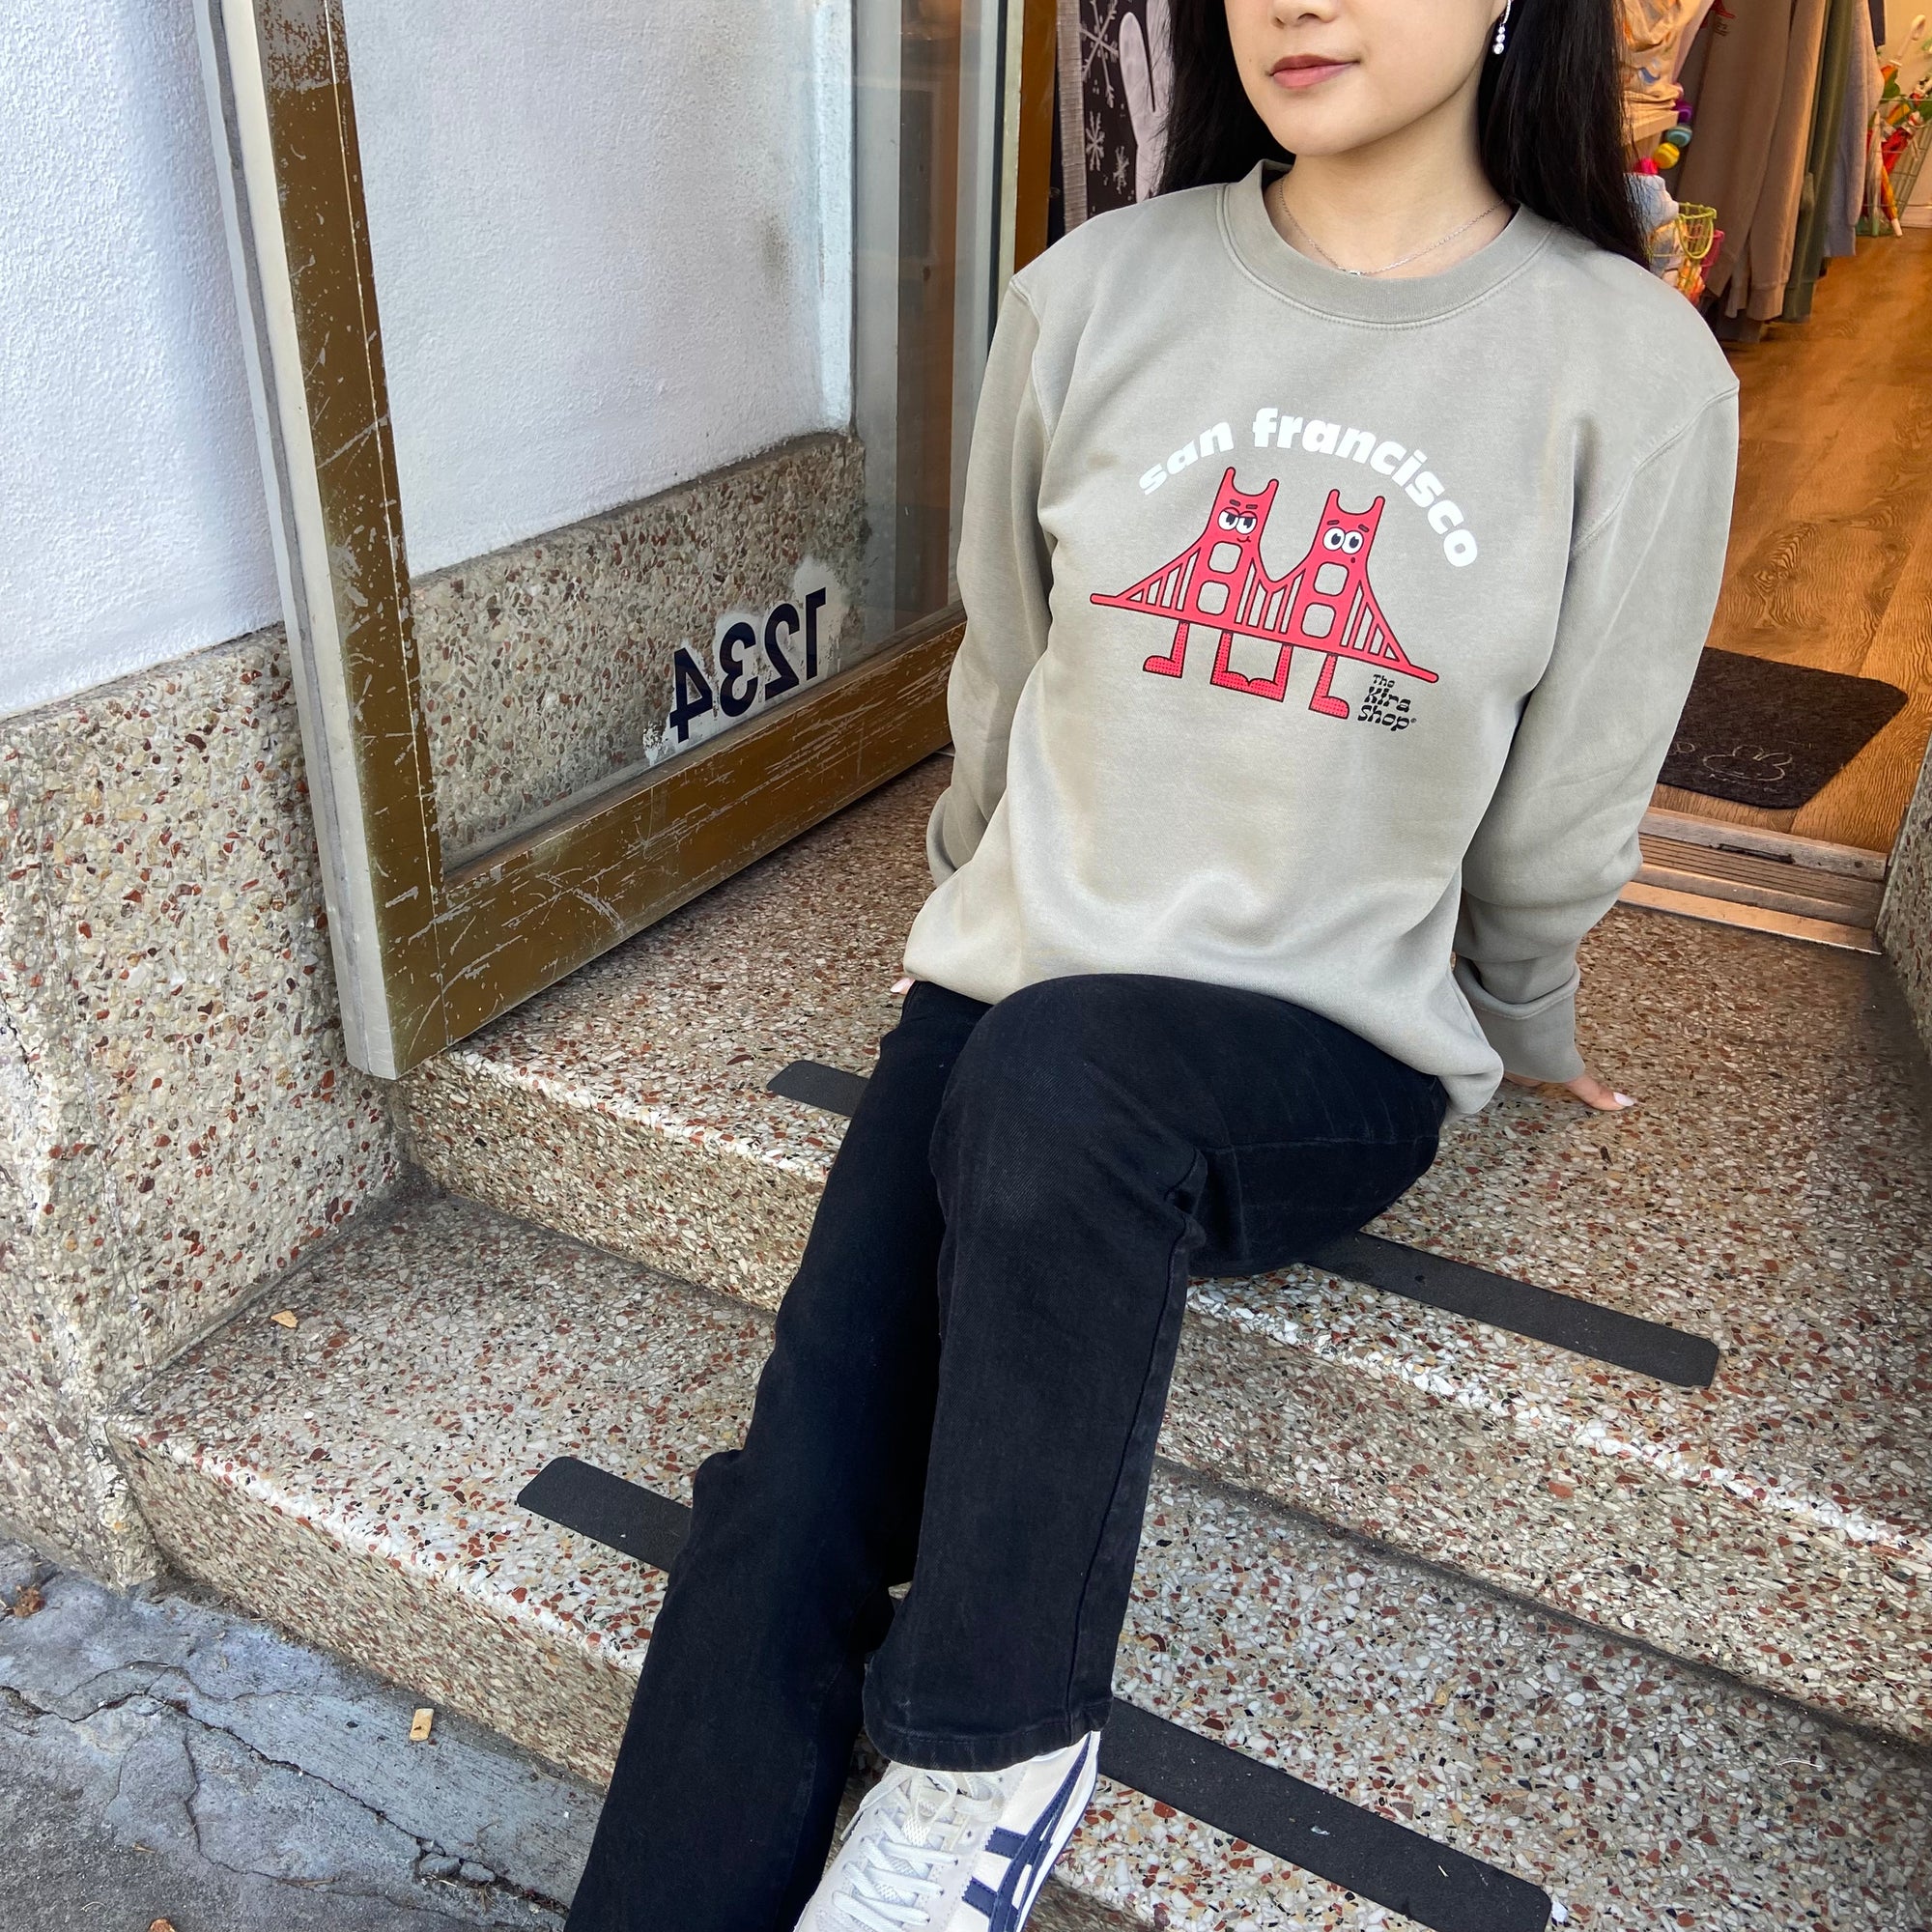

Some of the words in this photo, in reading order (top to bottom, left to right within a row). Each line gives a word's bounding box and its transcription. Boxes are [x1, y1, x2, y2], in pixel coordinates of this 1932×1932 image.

[1139, 421, 1235, 496] san
[1253, 408, 1478, 567] francisco
[1364, 686, 1411, 712] Kira
